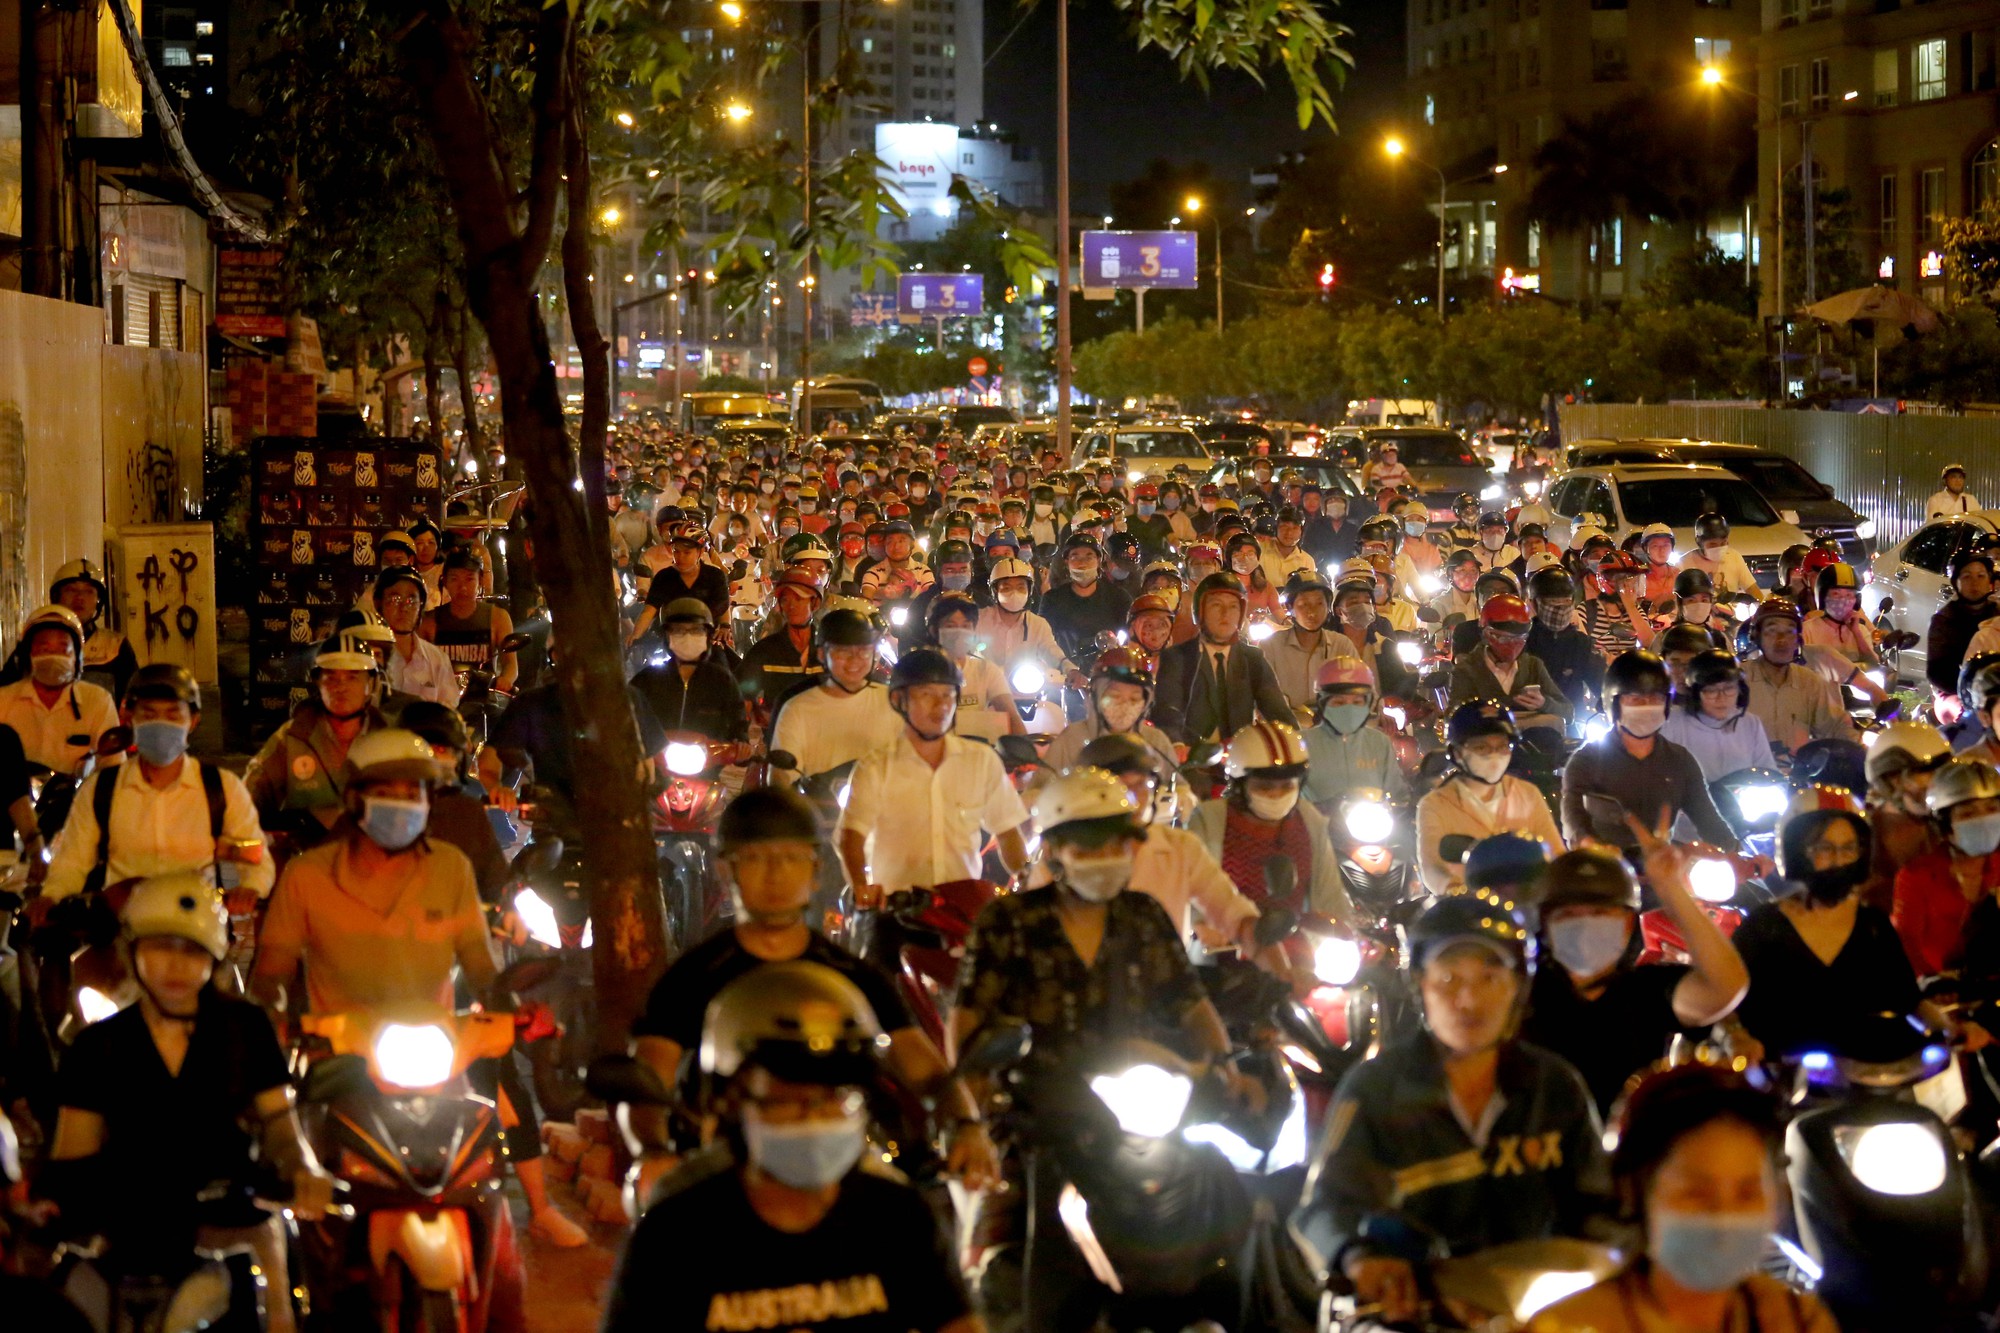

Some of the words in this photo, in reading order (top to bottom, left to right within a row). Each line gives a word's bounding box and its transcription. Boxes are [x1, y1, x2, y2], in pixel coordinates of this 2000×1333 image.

[1140, 246, 1161, 278] 3
[940, 285, 955, 308] 3
[266, 461, 292, 474] Tiger
[327, 462, 352, 476] Tiger
[388, 463, 414, 477] Tiger
[264, 540, 289, 553] Tiger
[325, 541, 350, 554] Tiger
[705, 1272, 889, 1332] AUSTRALIA
